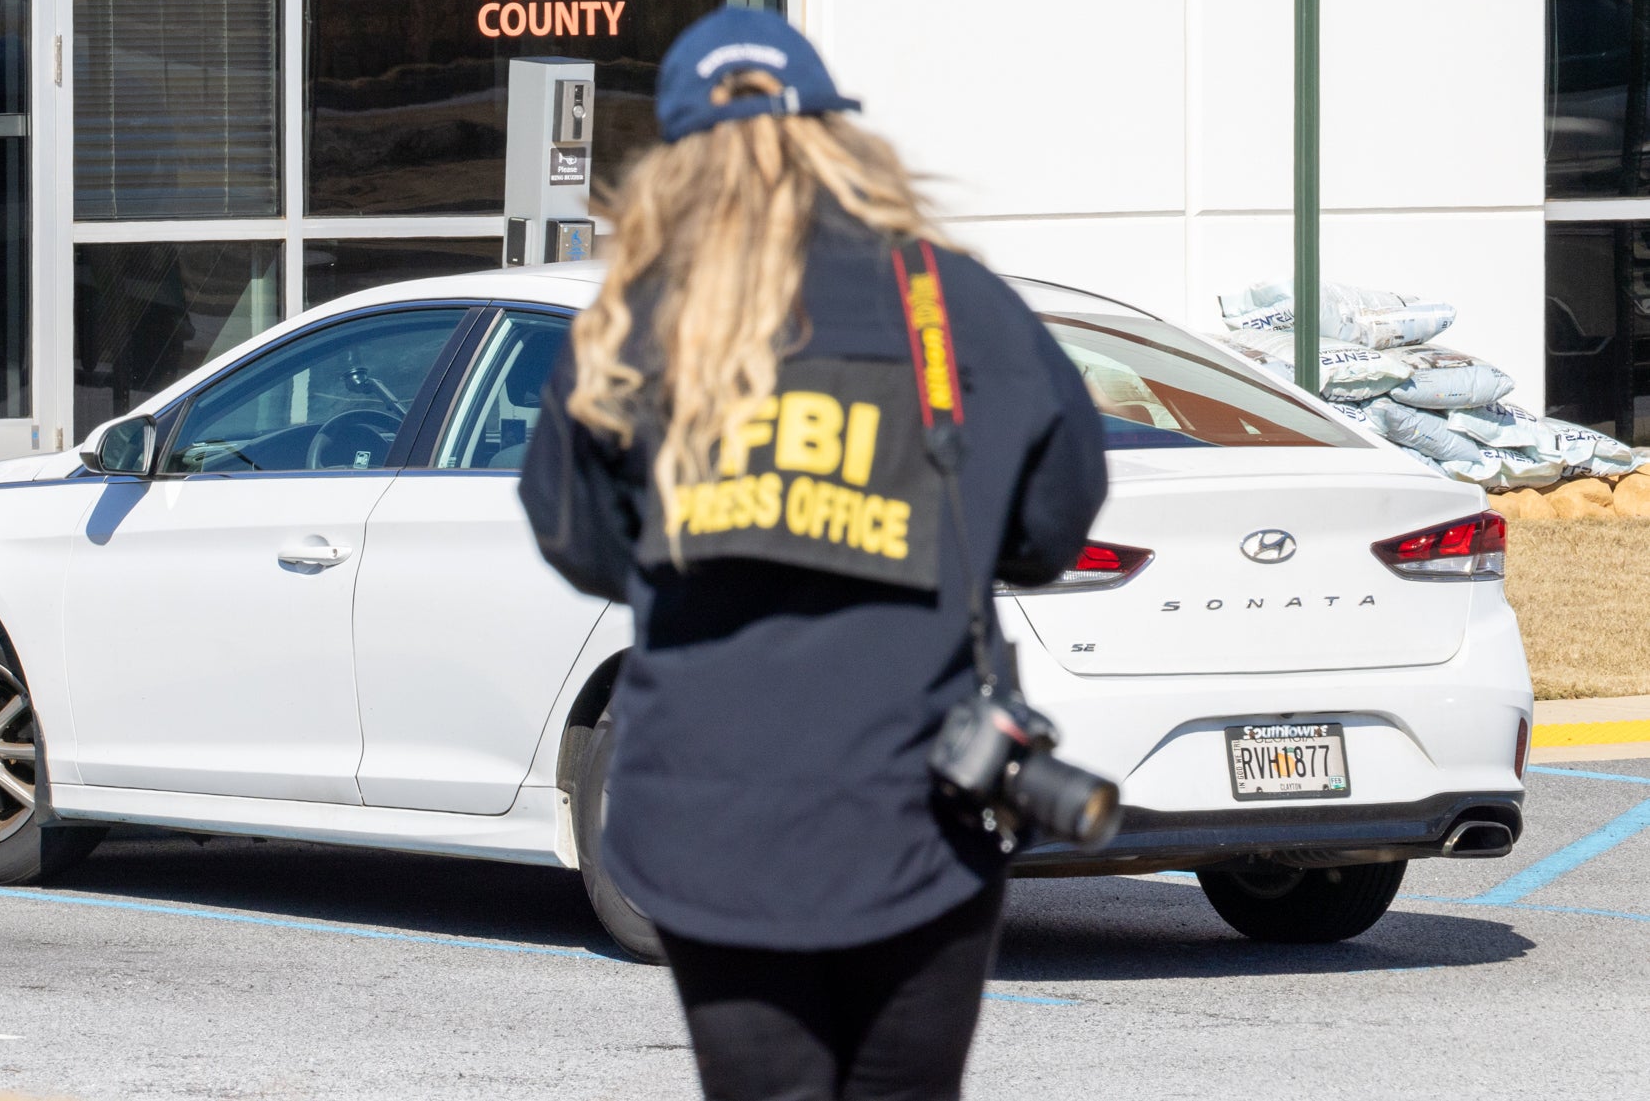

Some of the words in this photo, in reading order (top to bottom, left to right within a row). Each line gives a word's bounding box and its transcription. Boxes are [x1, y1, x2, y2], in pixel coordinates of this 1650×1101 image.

[477, 1, 625, 38] COUNTY
[557, 165, 578, 173] Please
[1320, 351, 1381, 367] CENTR
[720, 390, 881, 487] FBI
[786, 475, 912, 560] OFFICE
[1160, 594, 1377, 612] SONATA
[1070, 643, 1096, 653] SE
[1234, 755, 1242, 764] WE
[1241, 744, 1330, 780] RVH1877
[1235, 766, 1245, 780] GOD
[1279, 782, 1302, 791] CLAYTON
